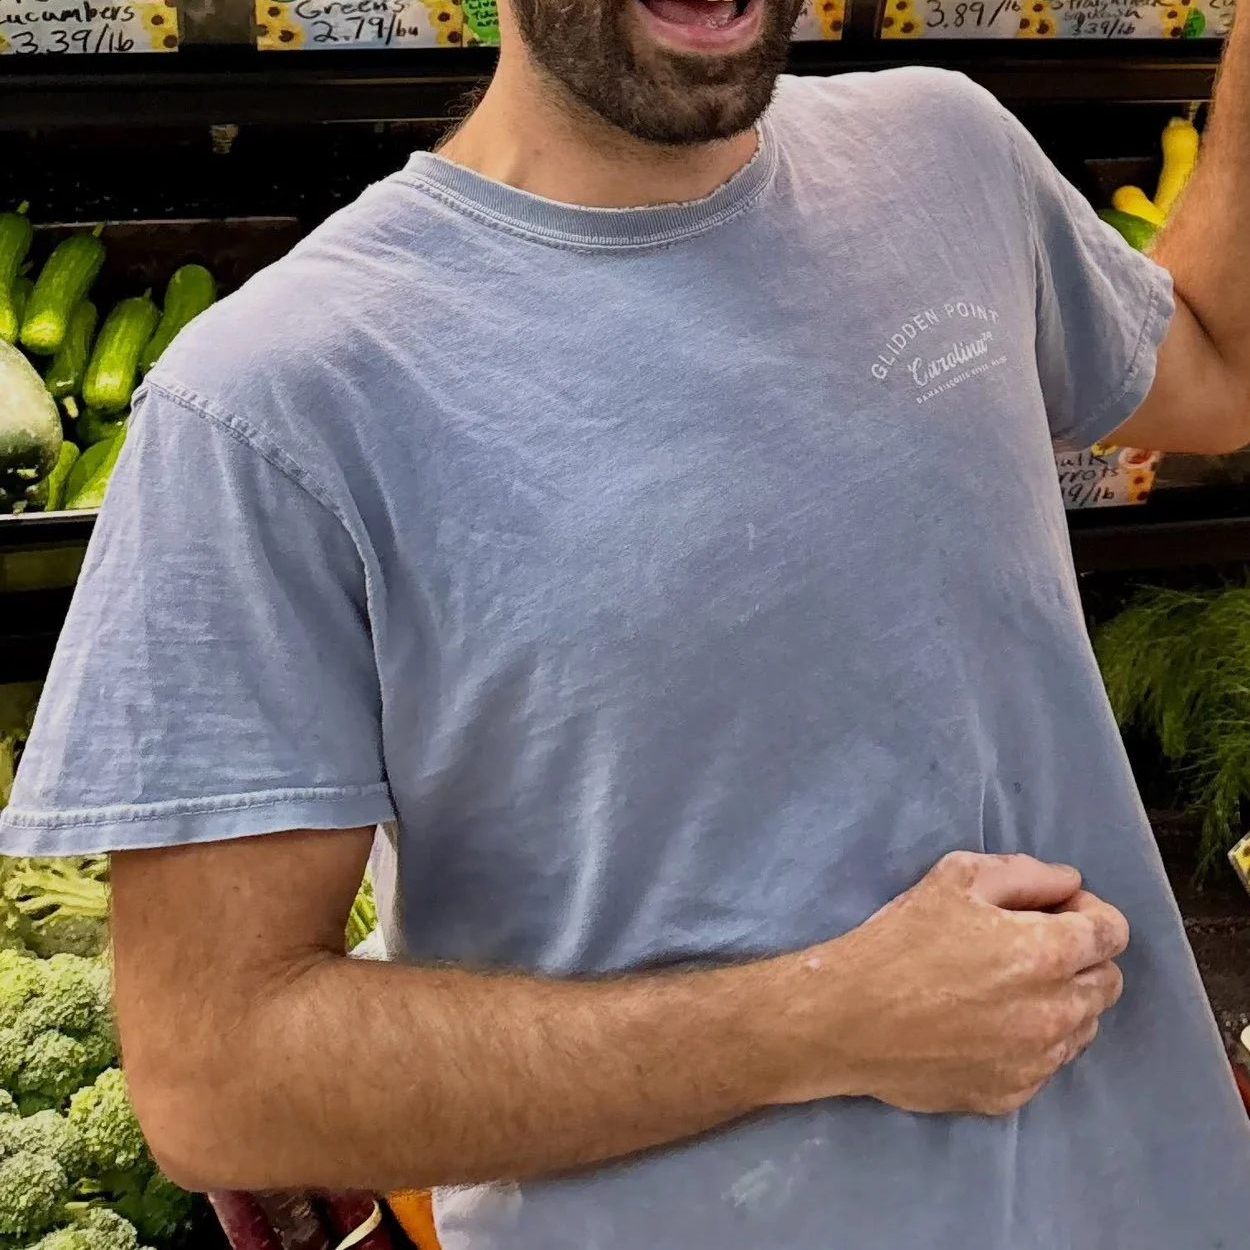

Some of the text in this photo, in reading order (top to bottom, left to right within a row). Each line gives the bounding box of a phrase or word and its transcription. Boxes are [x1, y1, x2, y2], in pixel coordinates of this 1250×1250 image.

[0, 0, 135, 23] ucumbers
[295, 0, 406, 19] Greens
[870, 308, 941, 381] GLIDDEN
[944, 301, 1000, 325] POINT
[907, 338, 989, 388] Carolina
[1056, 452, 1108, 467] ulk
[1059, 466, 1119, 484] rrots
